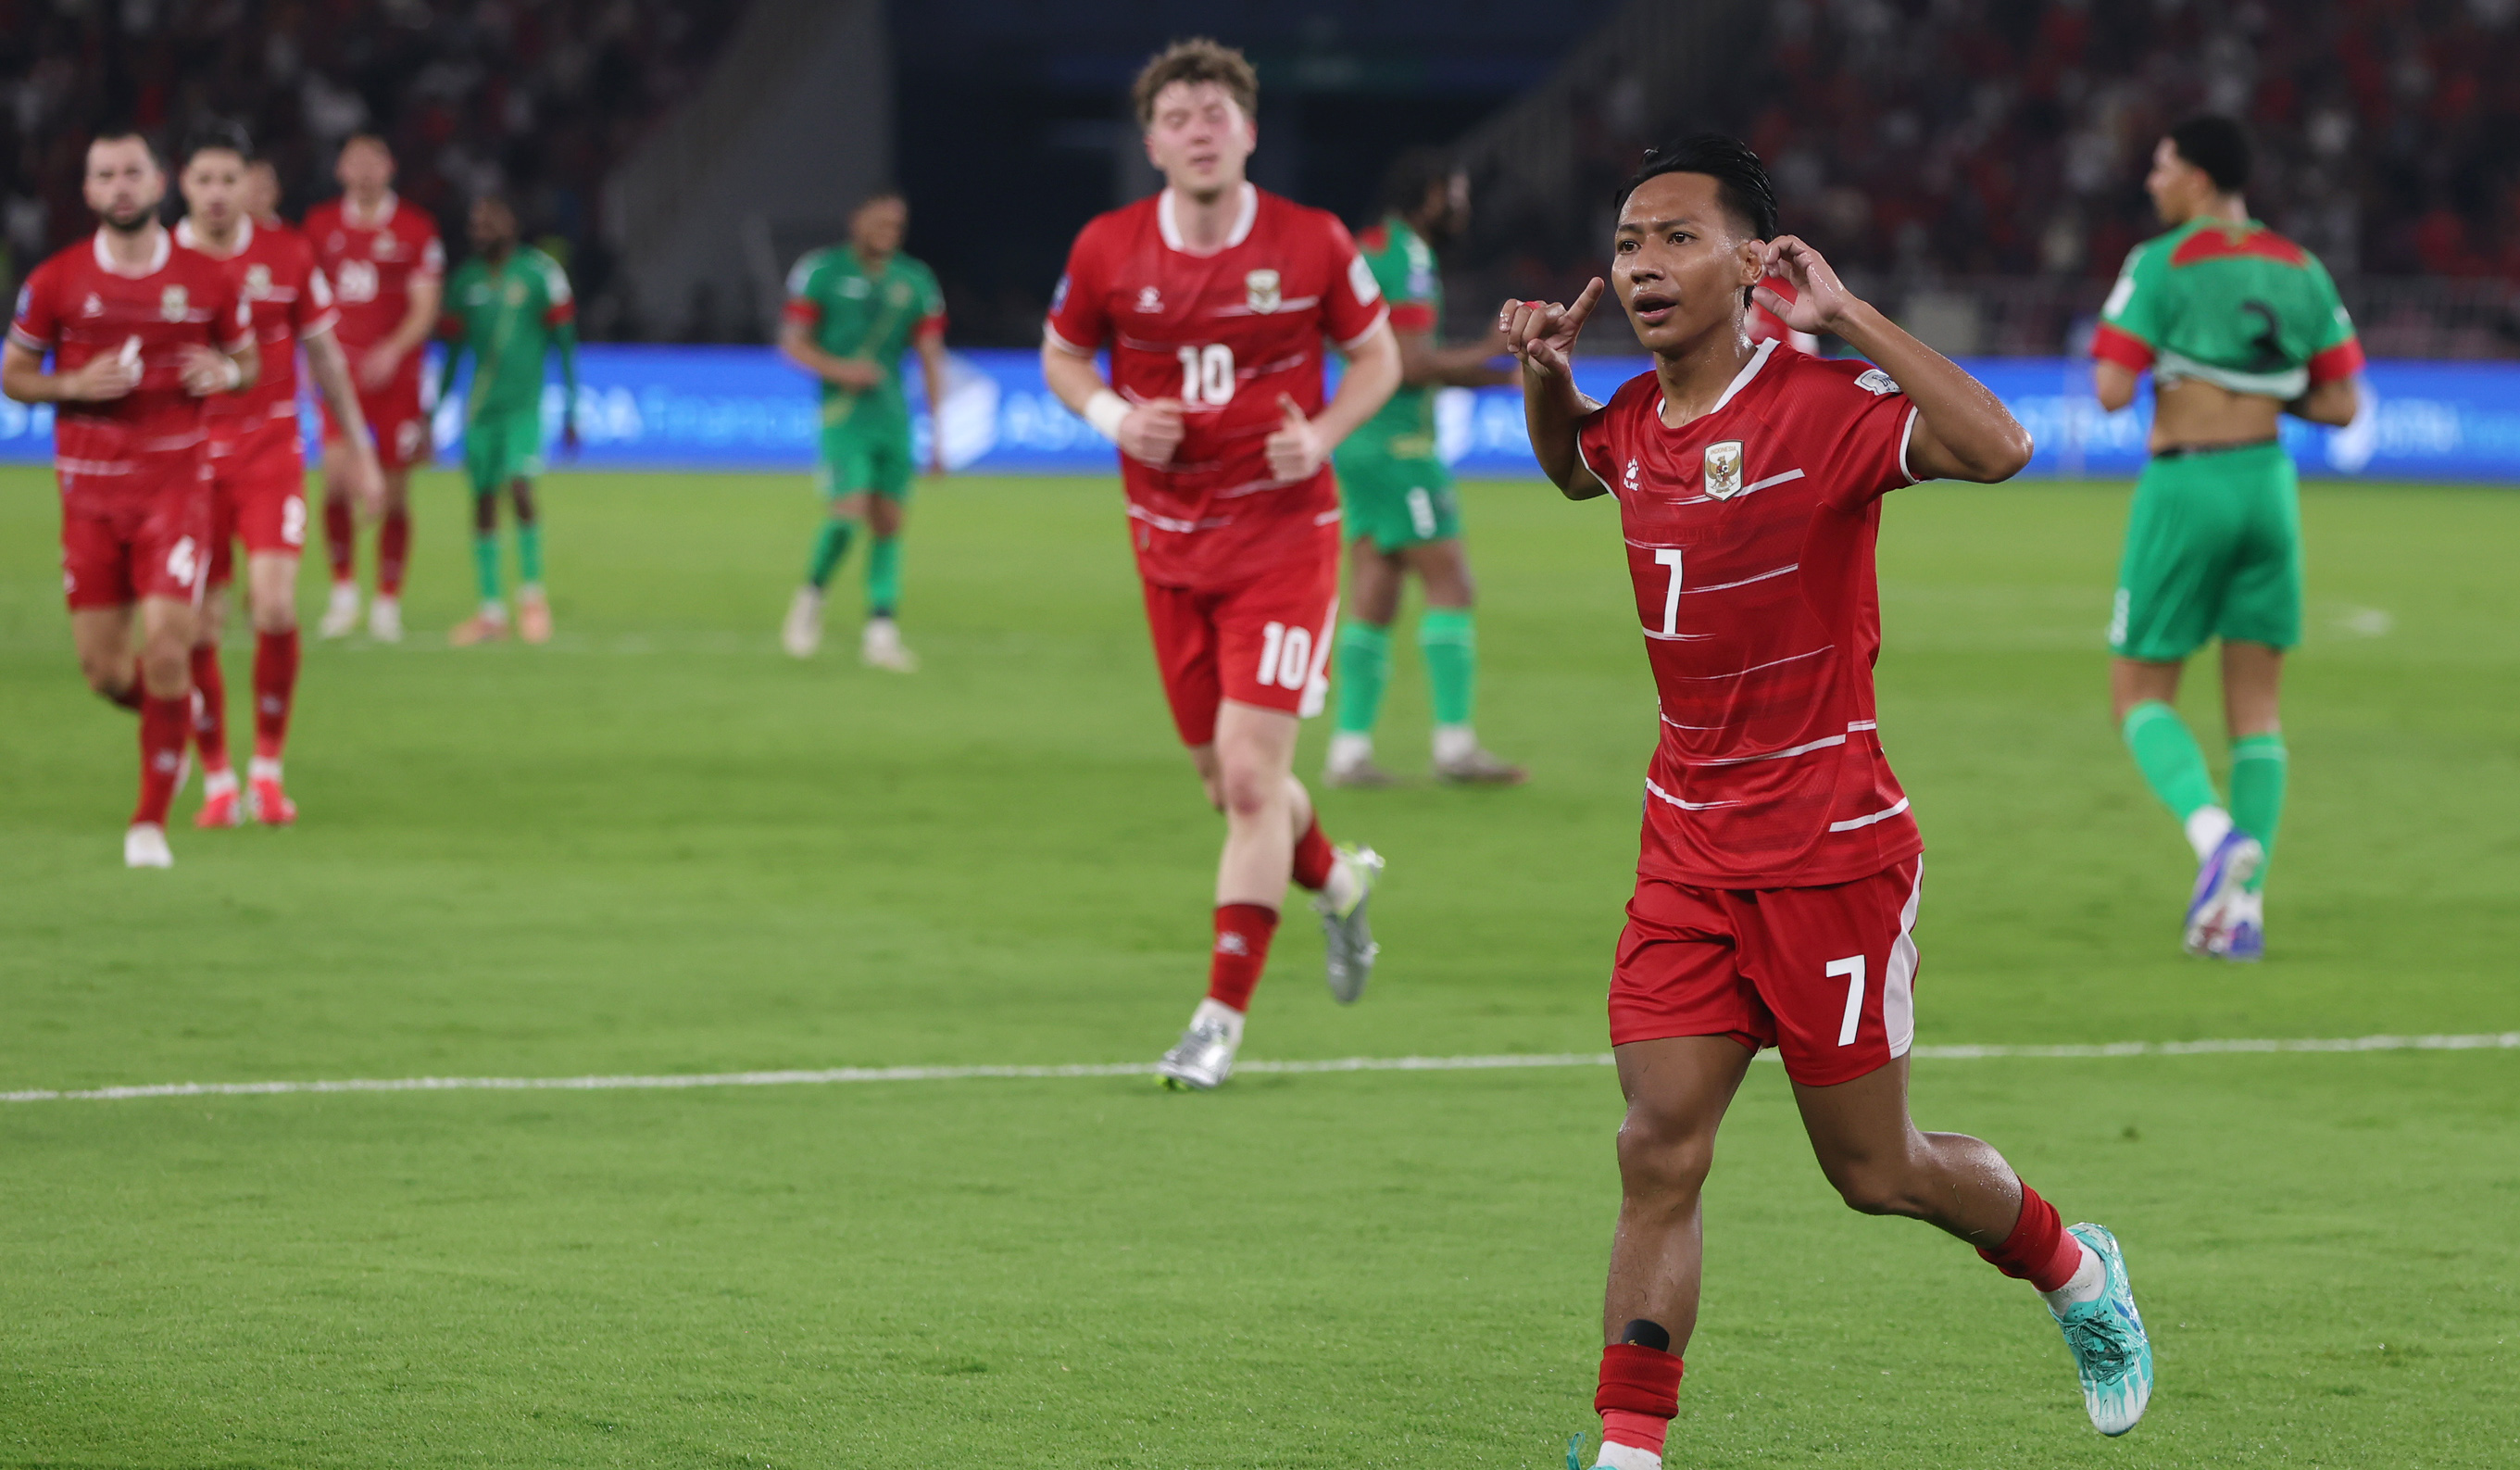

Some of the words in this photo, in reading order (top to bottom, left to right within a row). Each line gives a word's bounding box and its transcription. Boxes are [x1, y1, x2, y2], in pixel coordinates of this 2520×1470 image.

[1176, 344, 1235, 406] 10
[166, 534, 195, 587] 4
[1654, 548, 1683, 634] 7
[1256, 620, 1312, 691] 10
[1824, 954, 1865, 1047] 7
